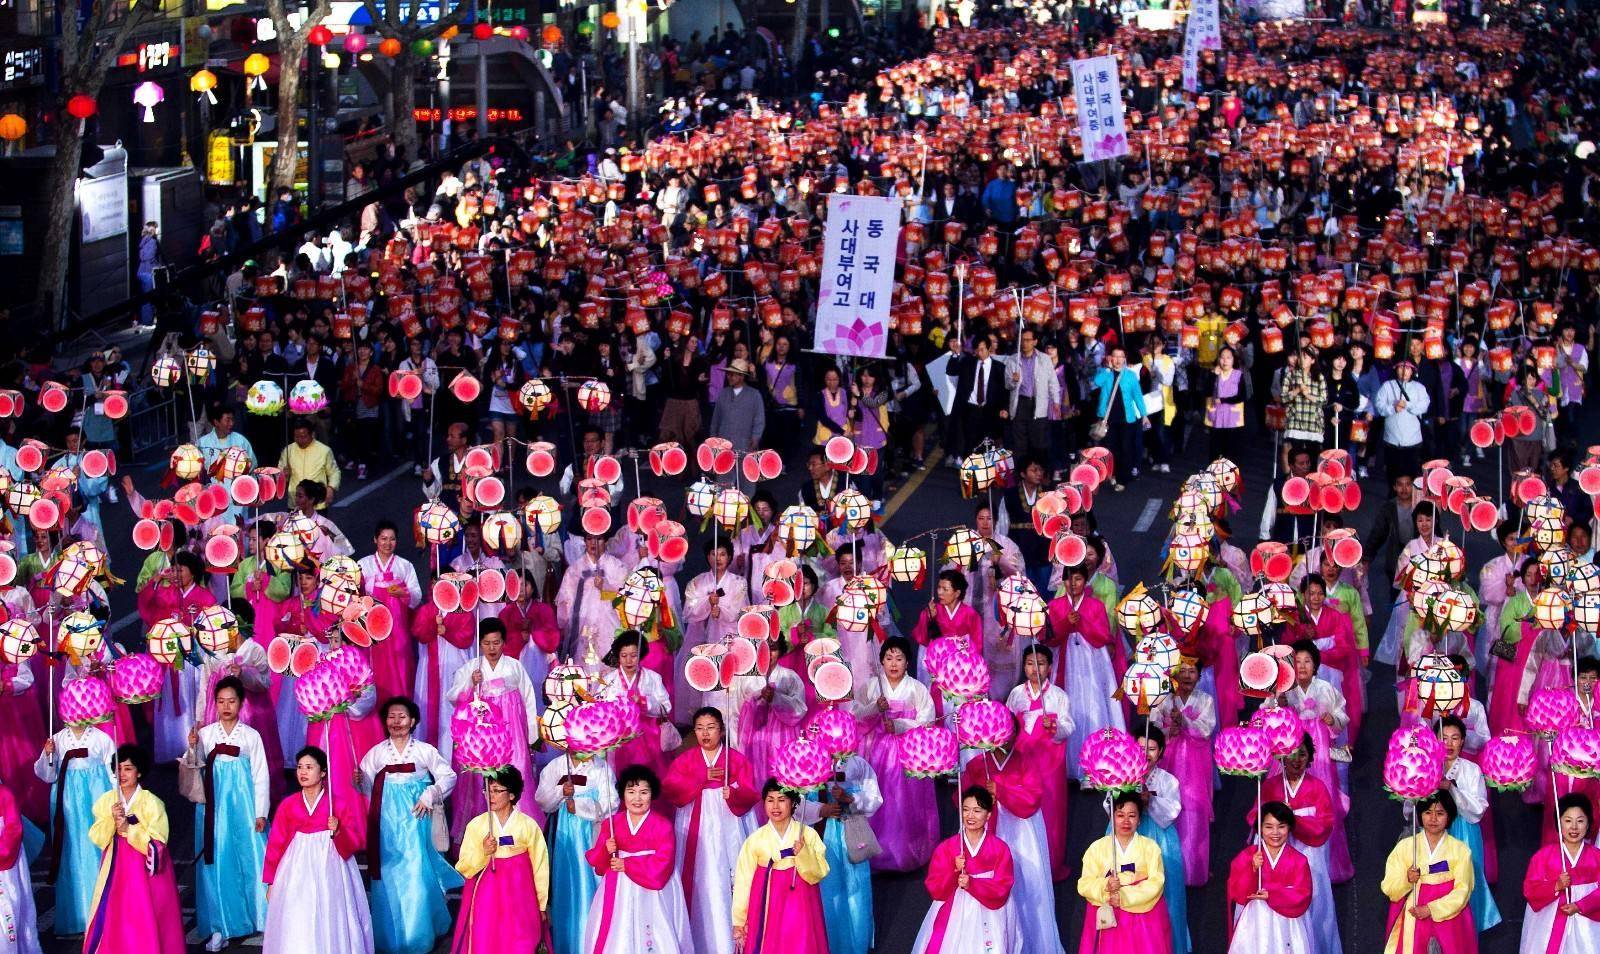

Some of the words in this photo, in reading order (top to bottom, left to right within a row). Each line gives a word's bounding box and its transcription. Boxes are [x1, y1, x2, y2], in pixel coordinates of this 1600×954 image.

[1082, 73, 1100, 131] 사대부여중
[1097, 70, 1115, 128] 동국대
[832, 219, 860, 307] 사대부여고
[859, 219, 884, 310] 동국대
